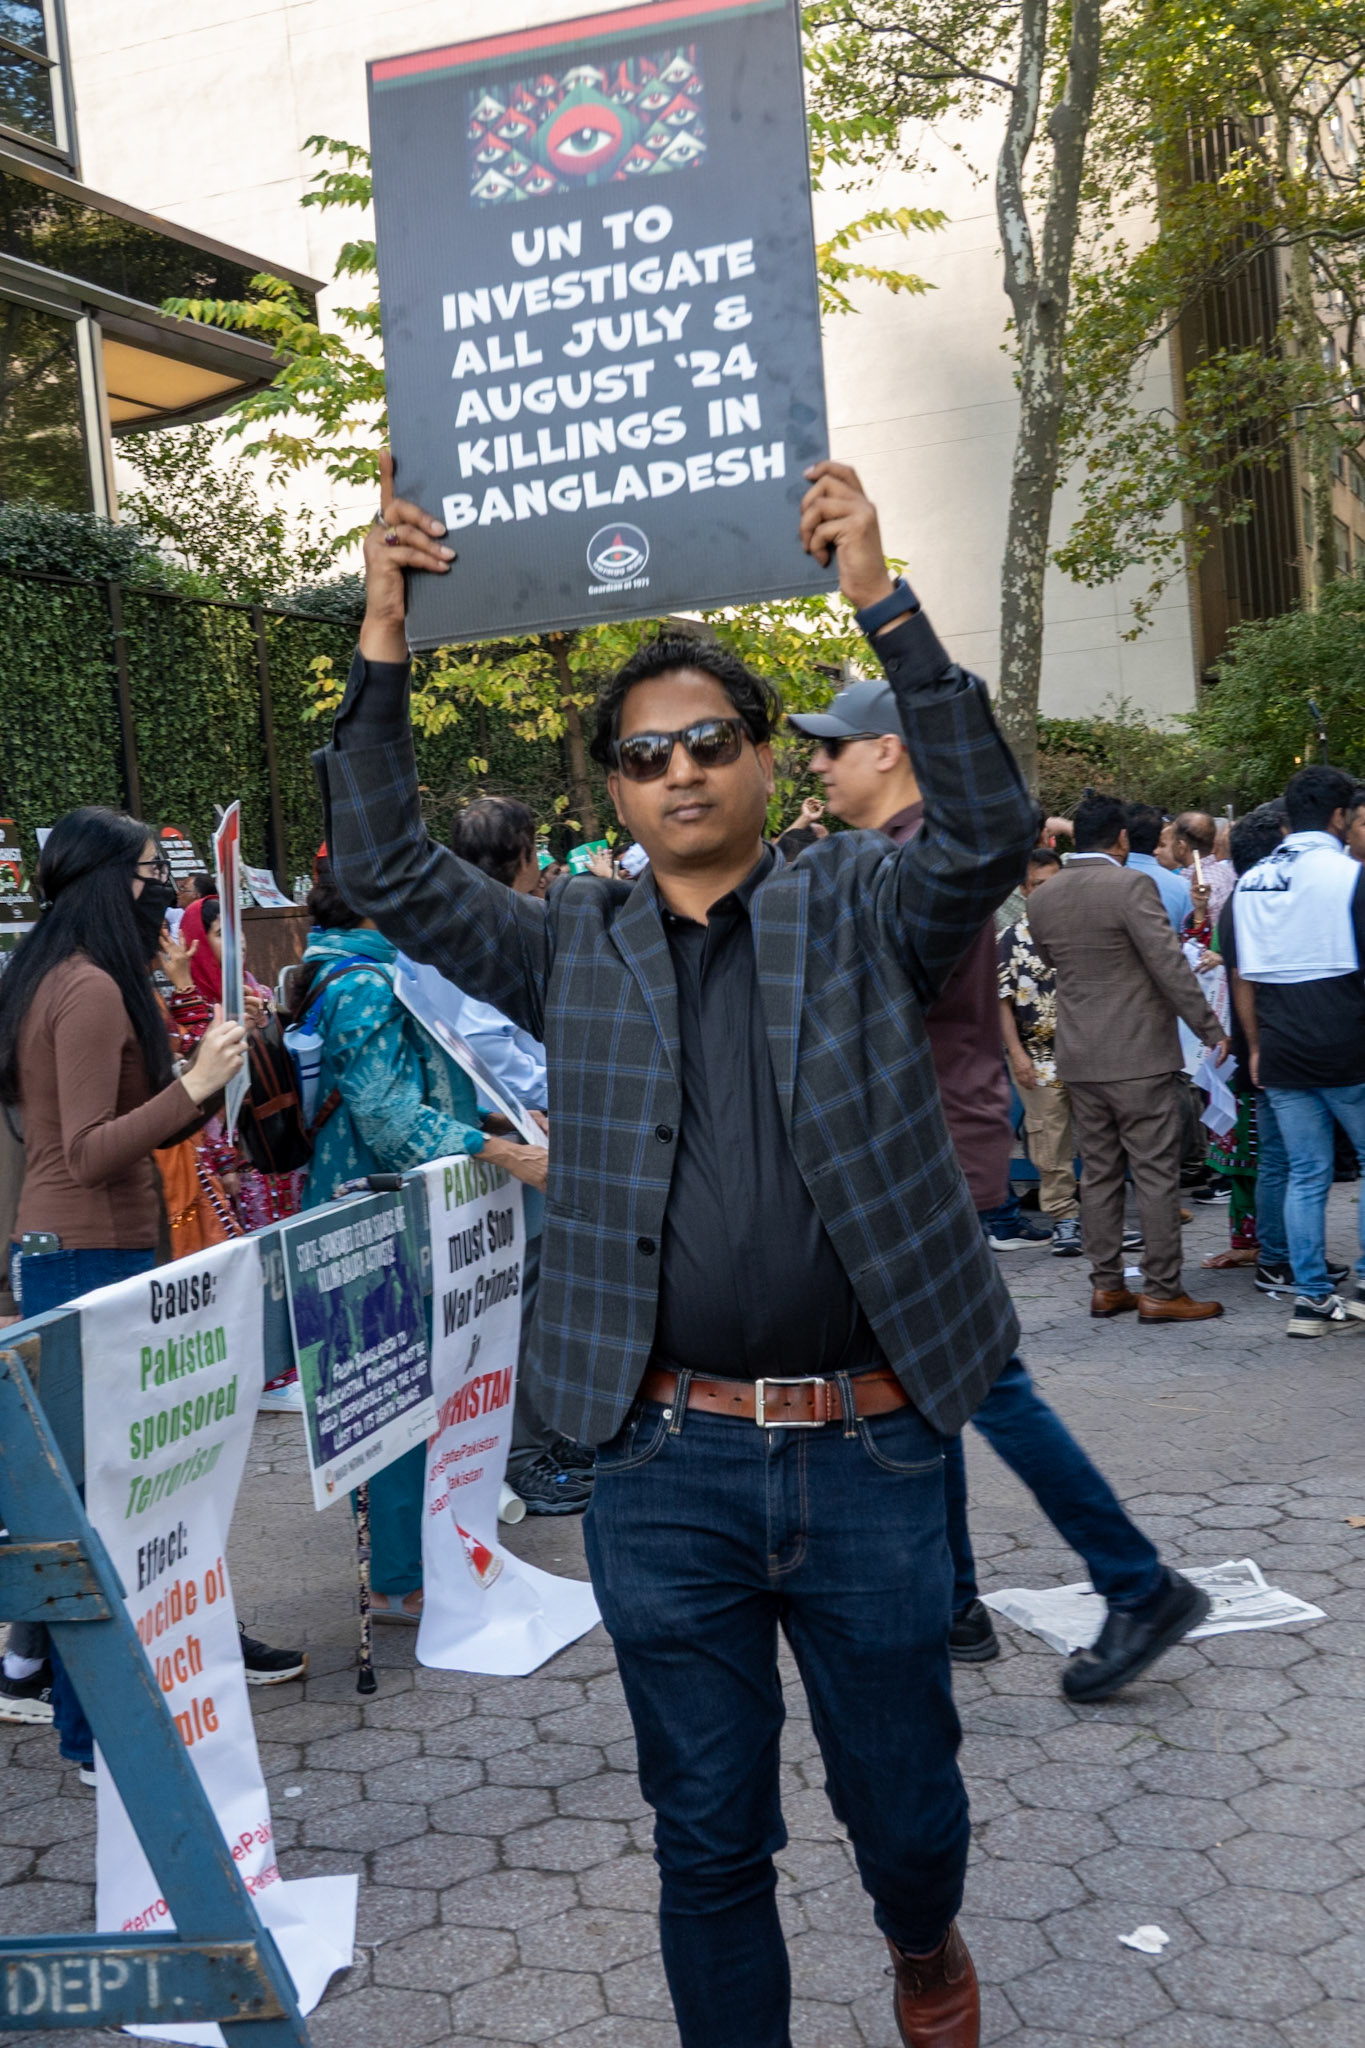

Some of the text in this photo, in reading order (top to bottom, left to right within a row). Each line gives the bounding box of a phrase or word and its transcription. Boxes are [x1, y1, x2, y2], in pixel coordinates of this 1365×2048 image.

[511, 204, 674, 268] UN TO
[442, 237, 756, 332] INVESTIGATE
[451, 294, 753, 380] ALL JULY &
[454, 358, 655, 429] AUGUST
[457, 393, 762, 479] KILLINGS IN
[441, 441, 786, 531] BANGLADESH
[150, 1270, 217, 1325] Cause:
[443, 1287, 473, 1338] War
[139, 1325, 227, 1392] Pakistan
[129, 1374, 238, 1460] sponsored
[125, 1440, 225, 1520] Terrorism
[137, 1521, 188, 1592] Effect:
[136, 1556, 226, 1646] nocide of
[7, 1952, 184, 2015] DEPT.
